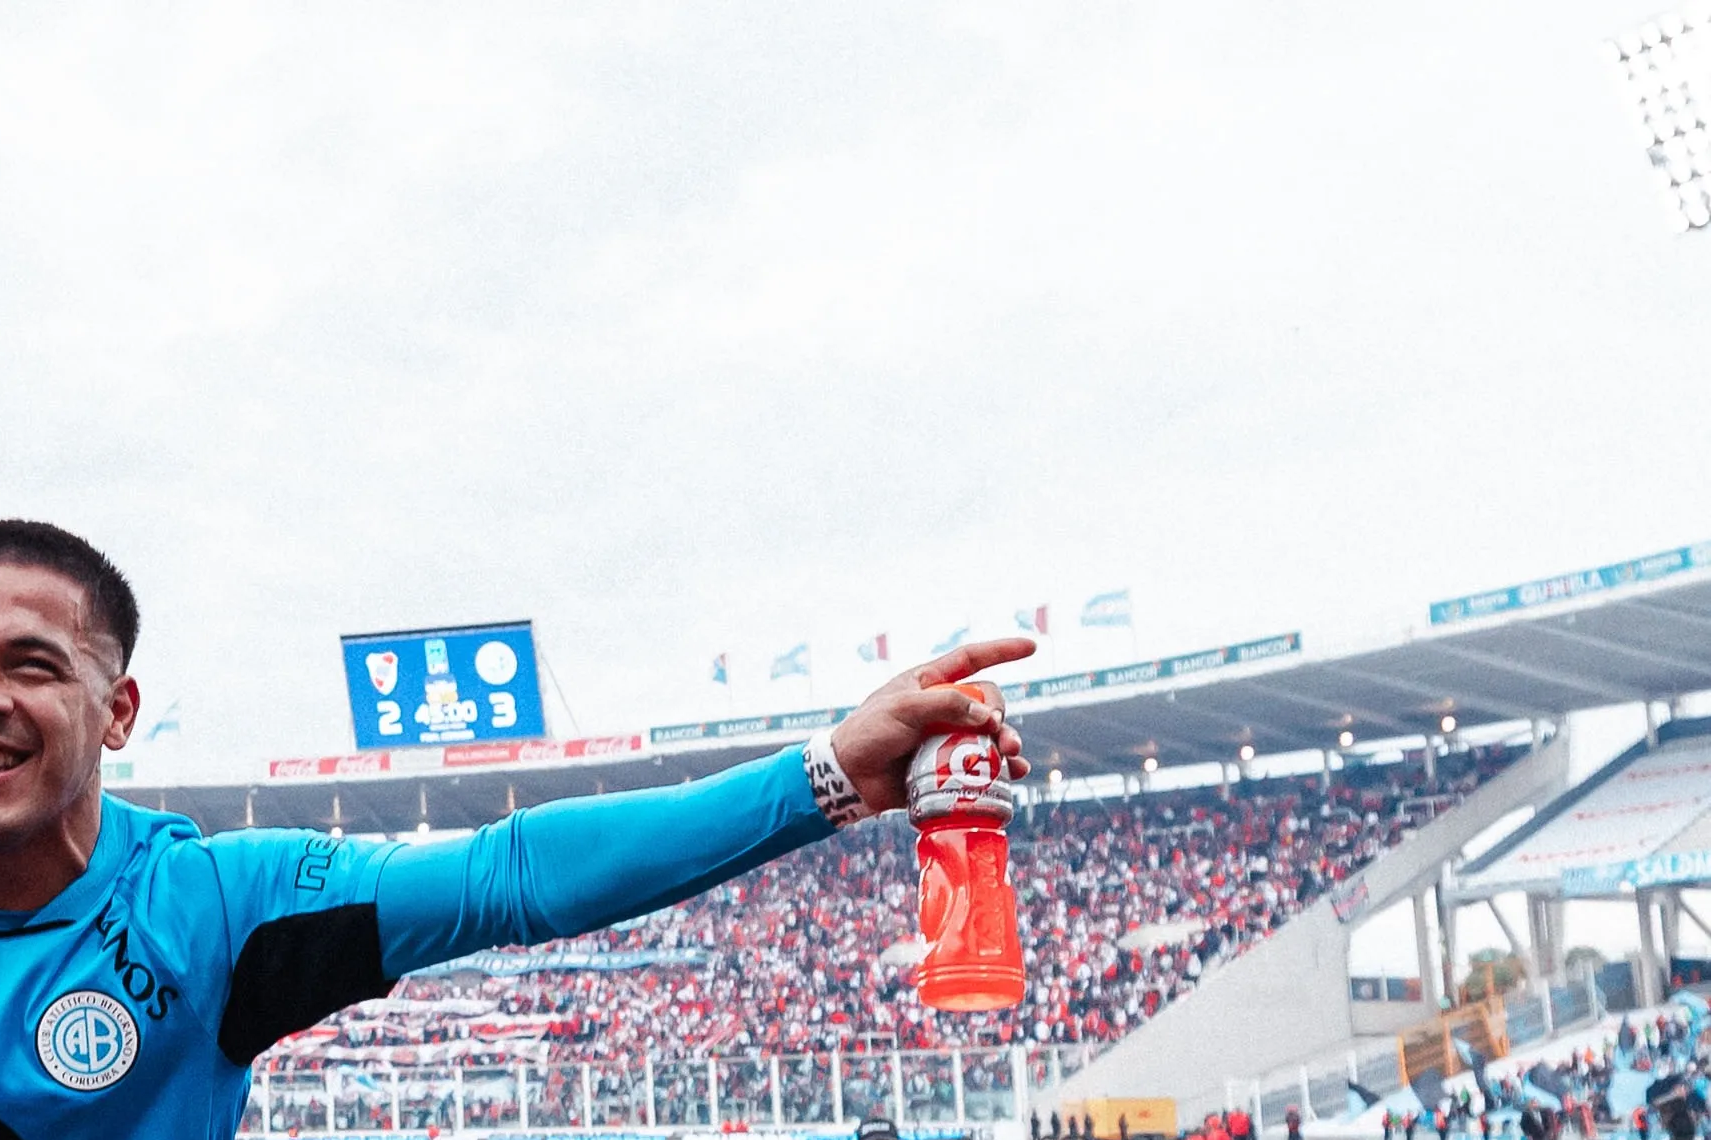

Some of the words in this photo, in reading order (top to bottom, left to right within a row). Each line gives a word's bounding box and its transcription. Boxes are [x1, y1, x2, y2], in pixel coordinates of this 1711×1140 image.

[376, 700, 404, 736] 2
[489, 691, 518, 729] 3
[949, 743, 994, 787] G
[96, 908, 178, 1021] ANOS
